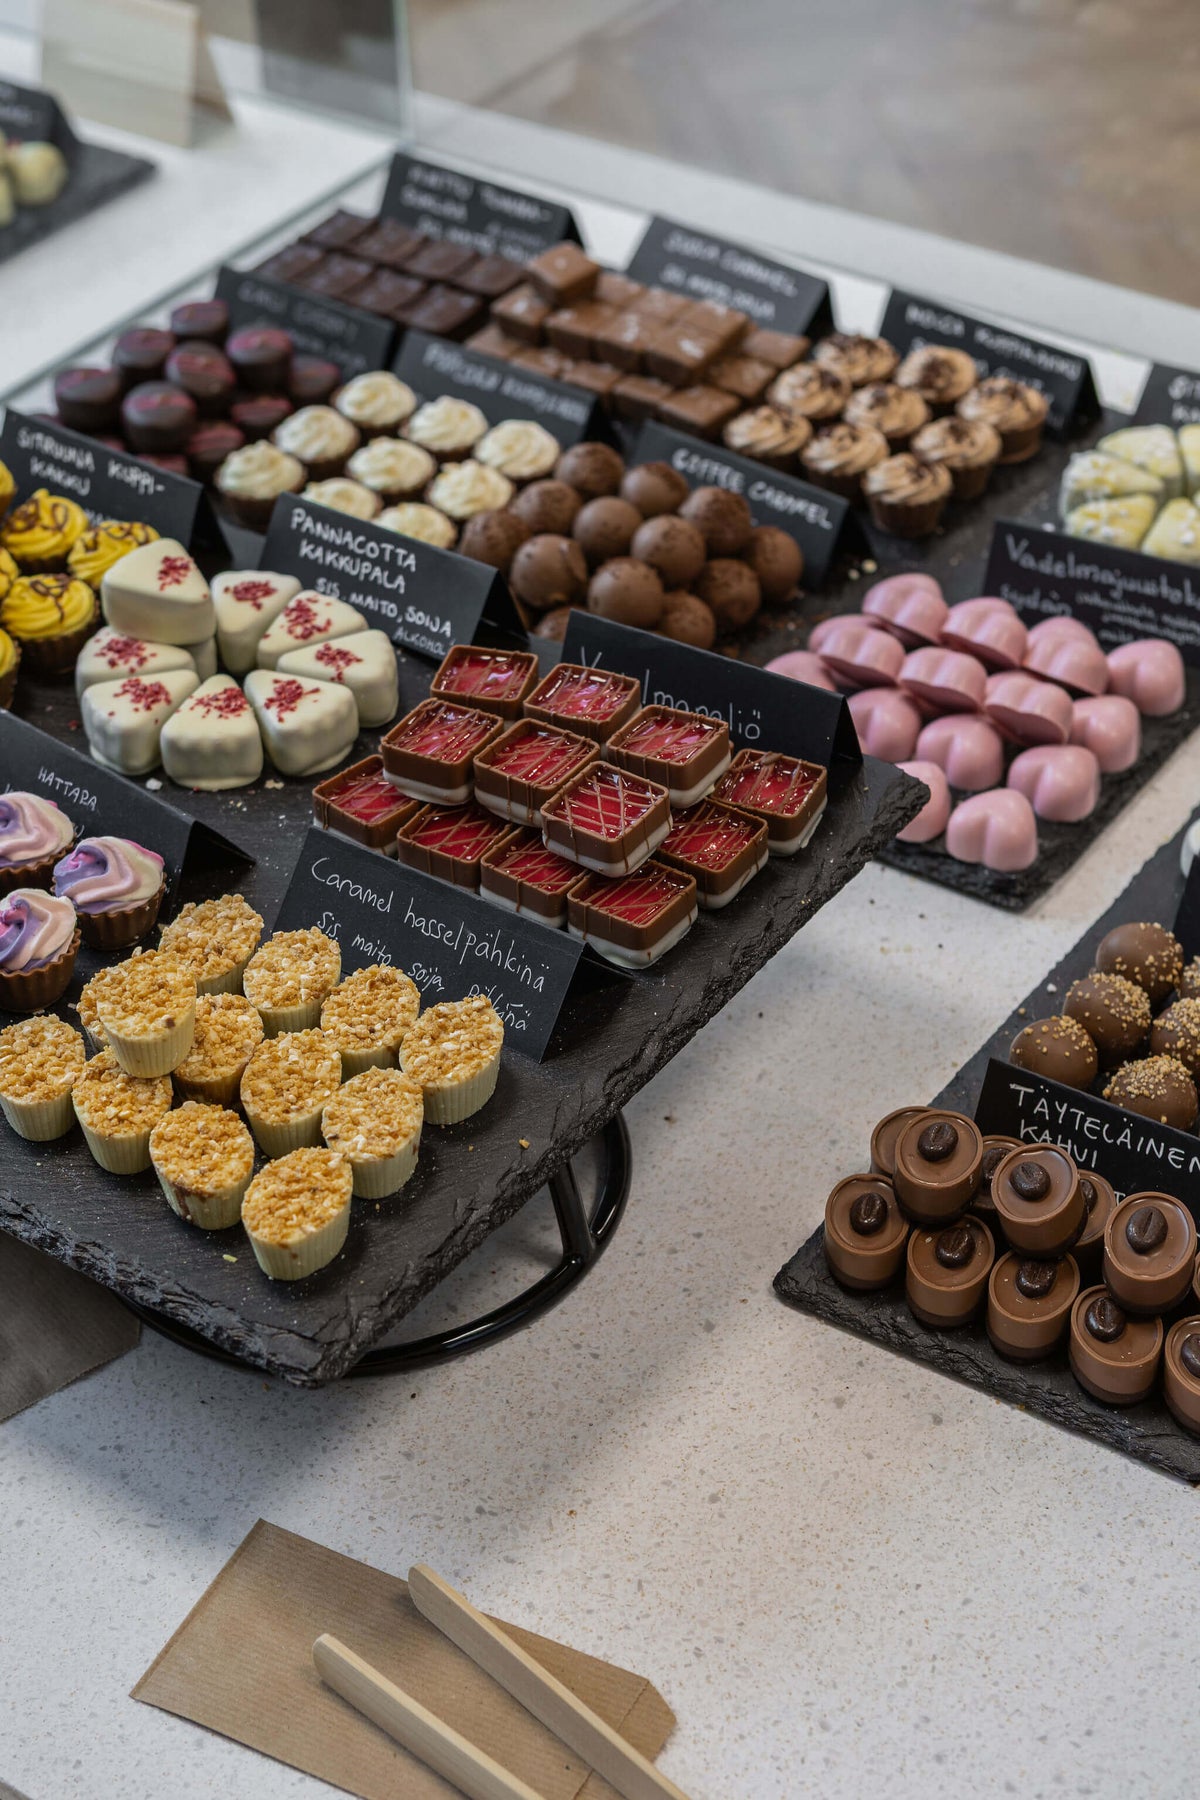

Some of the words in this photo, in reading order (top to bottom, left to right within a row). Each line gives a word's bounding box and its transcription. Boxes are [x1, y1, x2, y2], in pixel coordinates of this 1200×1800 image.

[671, 447, 745, 494] COFFEE
[290, 507, 417, 573] PANNACOTTA
[299, 540, 406, 594] KAKKUPALA
[311, 857, 394, 913] Caramel
[403, 897, 551, 993] hasselpähkinä
[317, 911, 341, 941] Sis.
